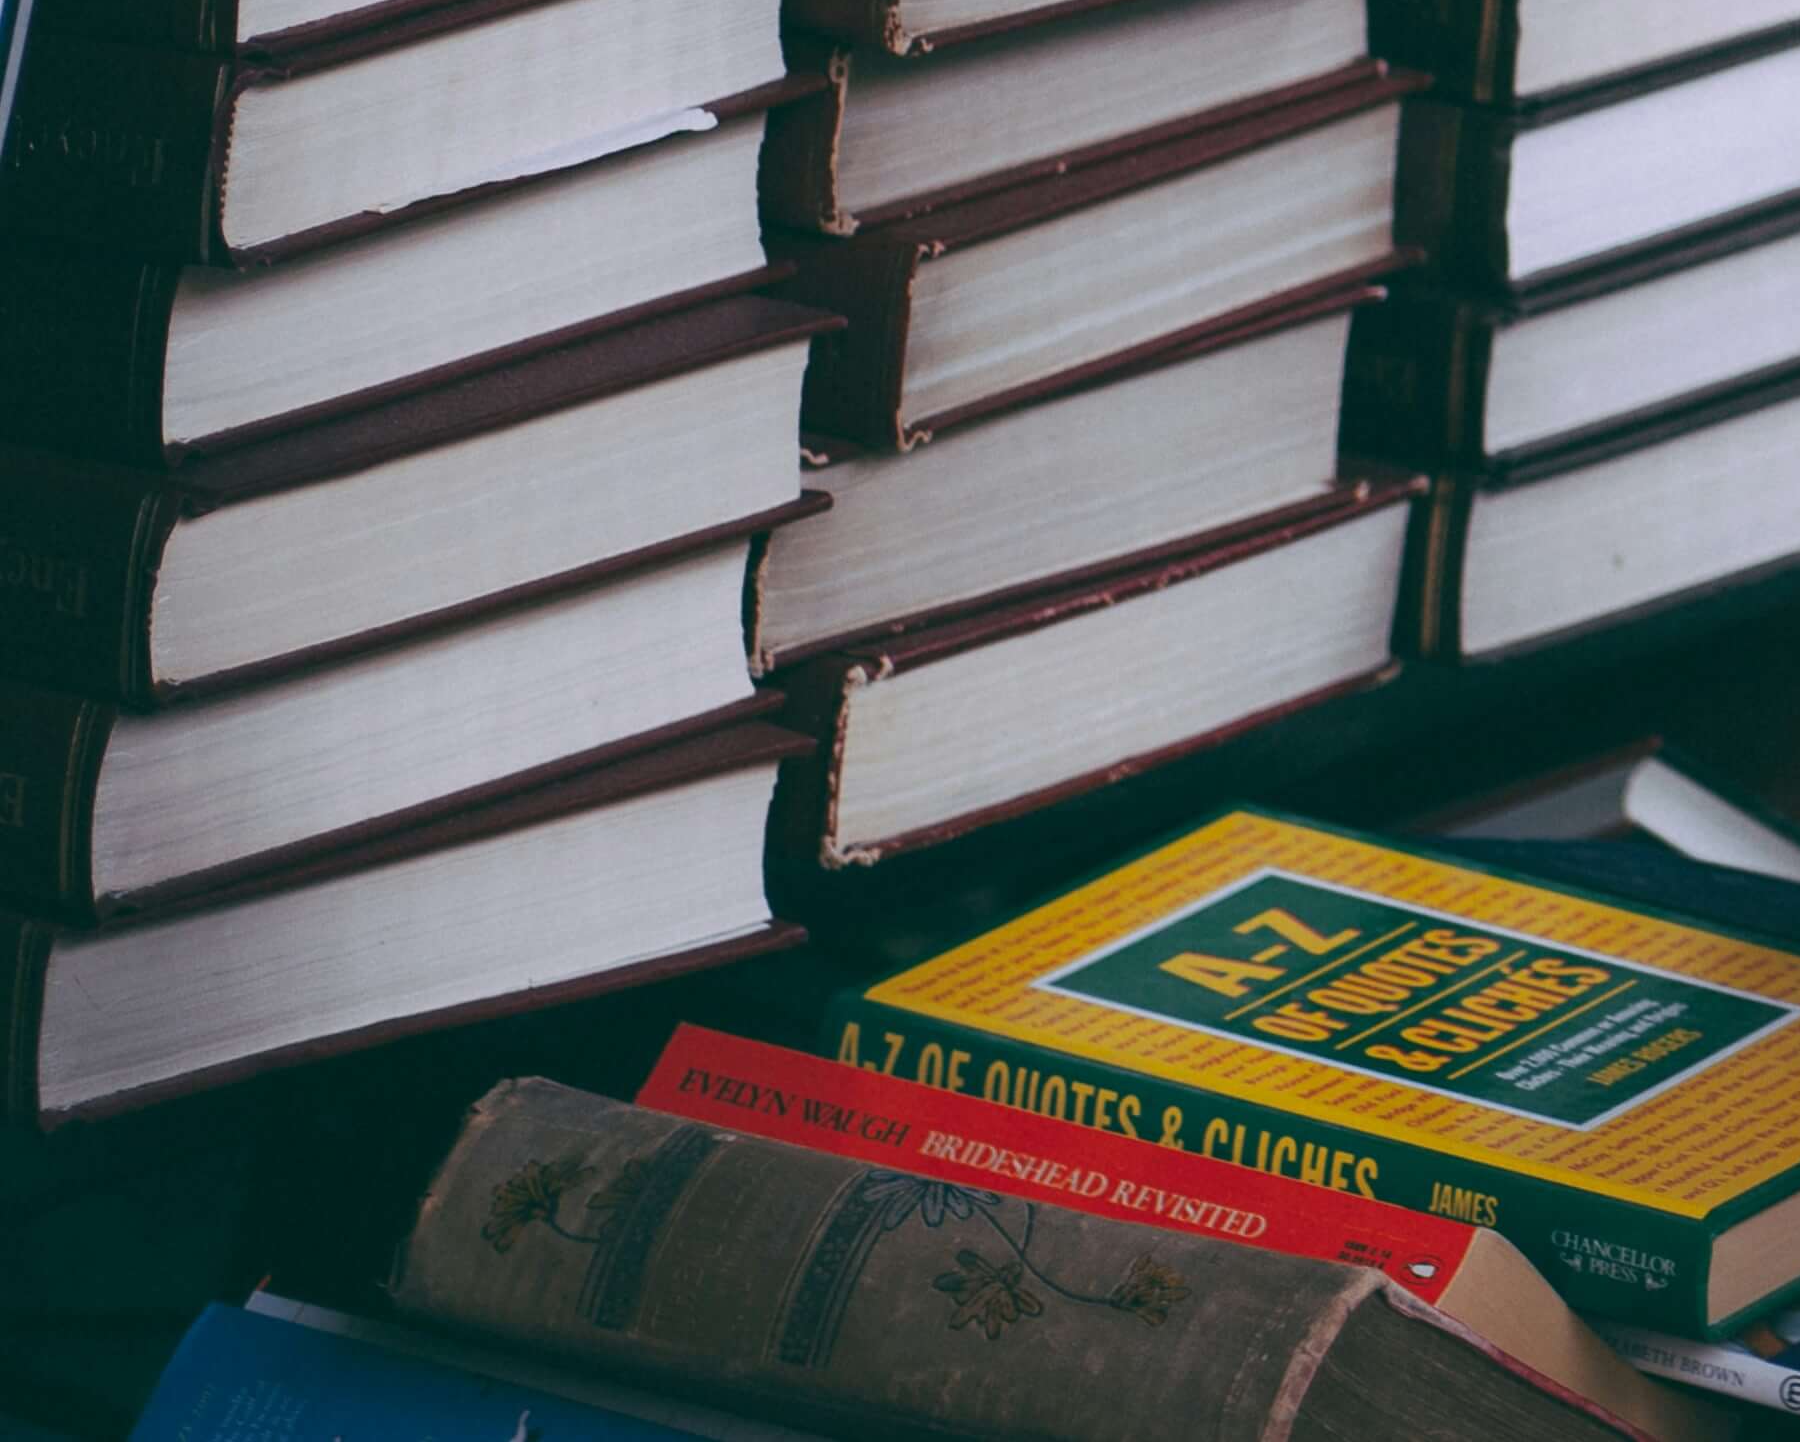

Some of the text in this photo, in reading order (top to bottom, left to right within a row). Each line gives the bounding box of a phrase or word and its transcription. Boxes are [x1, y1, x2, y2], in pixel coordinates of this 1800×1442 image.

[1158, 908, 1361, 998] A-Z
[1251, 1001, 1349, 1042] OF
[1306, 929, 1500, 1015] QUOTES
[1400, 958, 1610, 1053] CLICHÉS
[1364, 1044, 1453, 1072] &
[676, 1067, 1268, 1239] EVELYN WAUGH BRIDESHEAD REVISITED
[837, 1022, 904, 1075] A-Z
[916, 1043, 971, 1093] OF
[983, 1059, 1142, 1141] QUOTES
[1158, 1106, 1185, 1152] &
[1429, 1182, 1499, 1227] JAMES
[1551, 1229, 1677, 1277] CHANCELLOR
[1588, 1256, 1639, 1284] PRESS
[1681, 1356, 1747, 1388] BROWN
